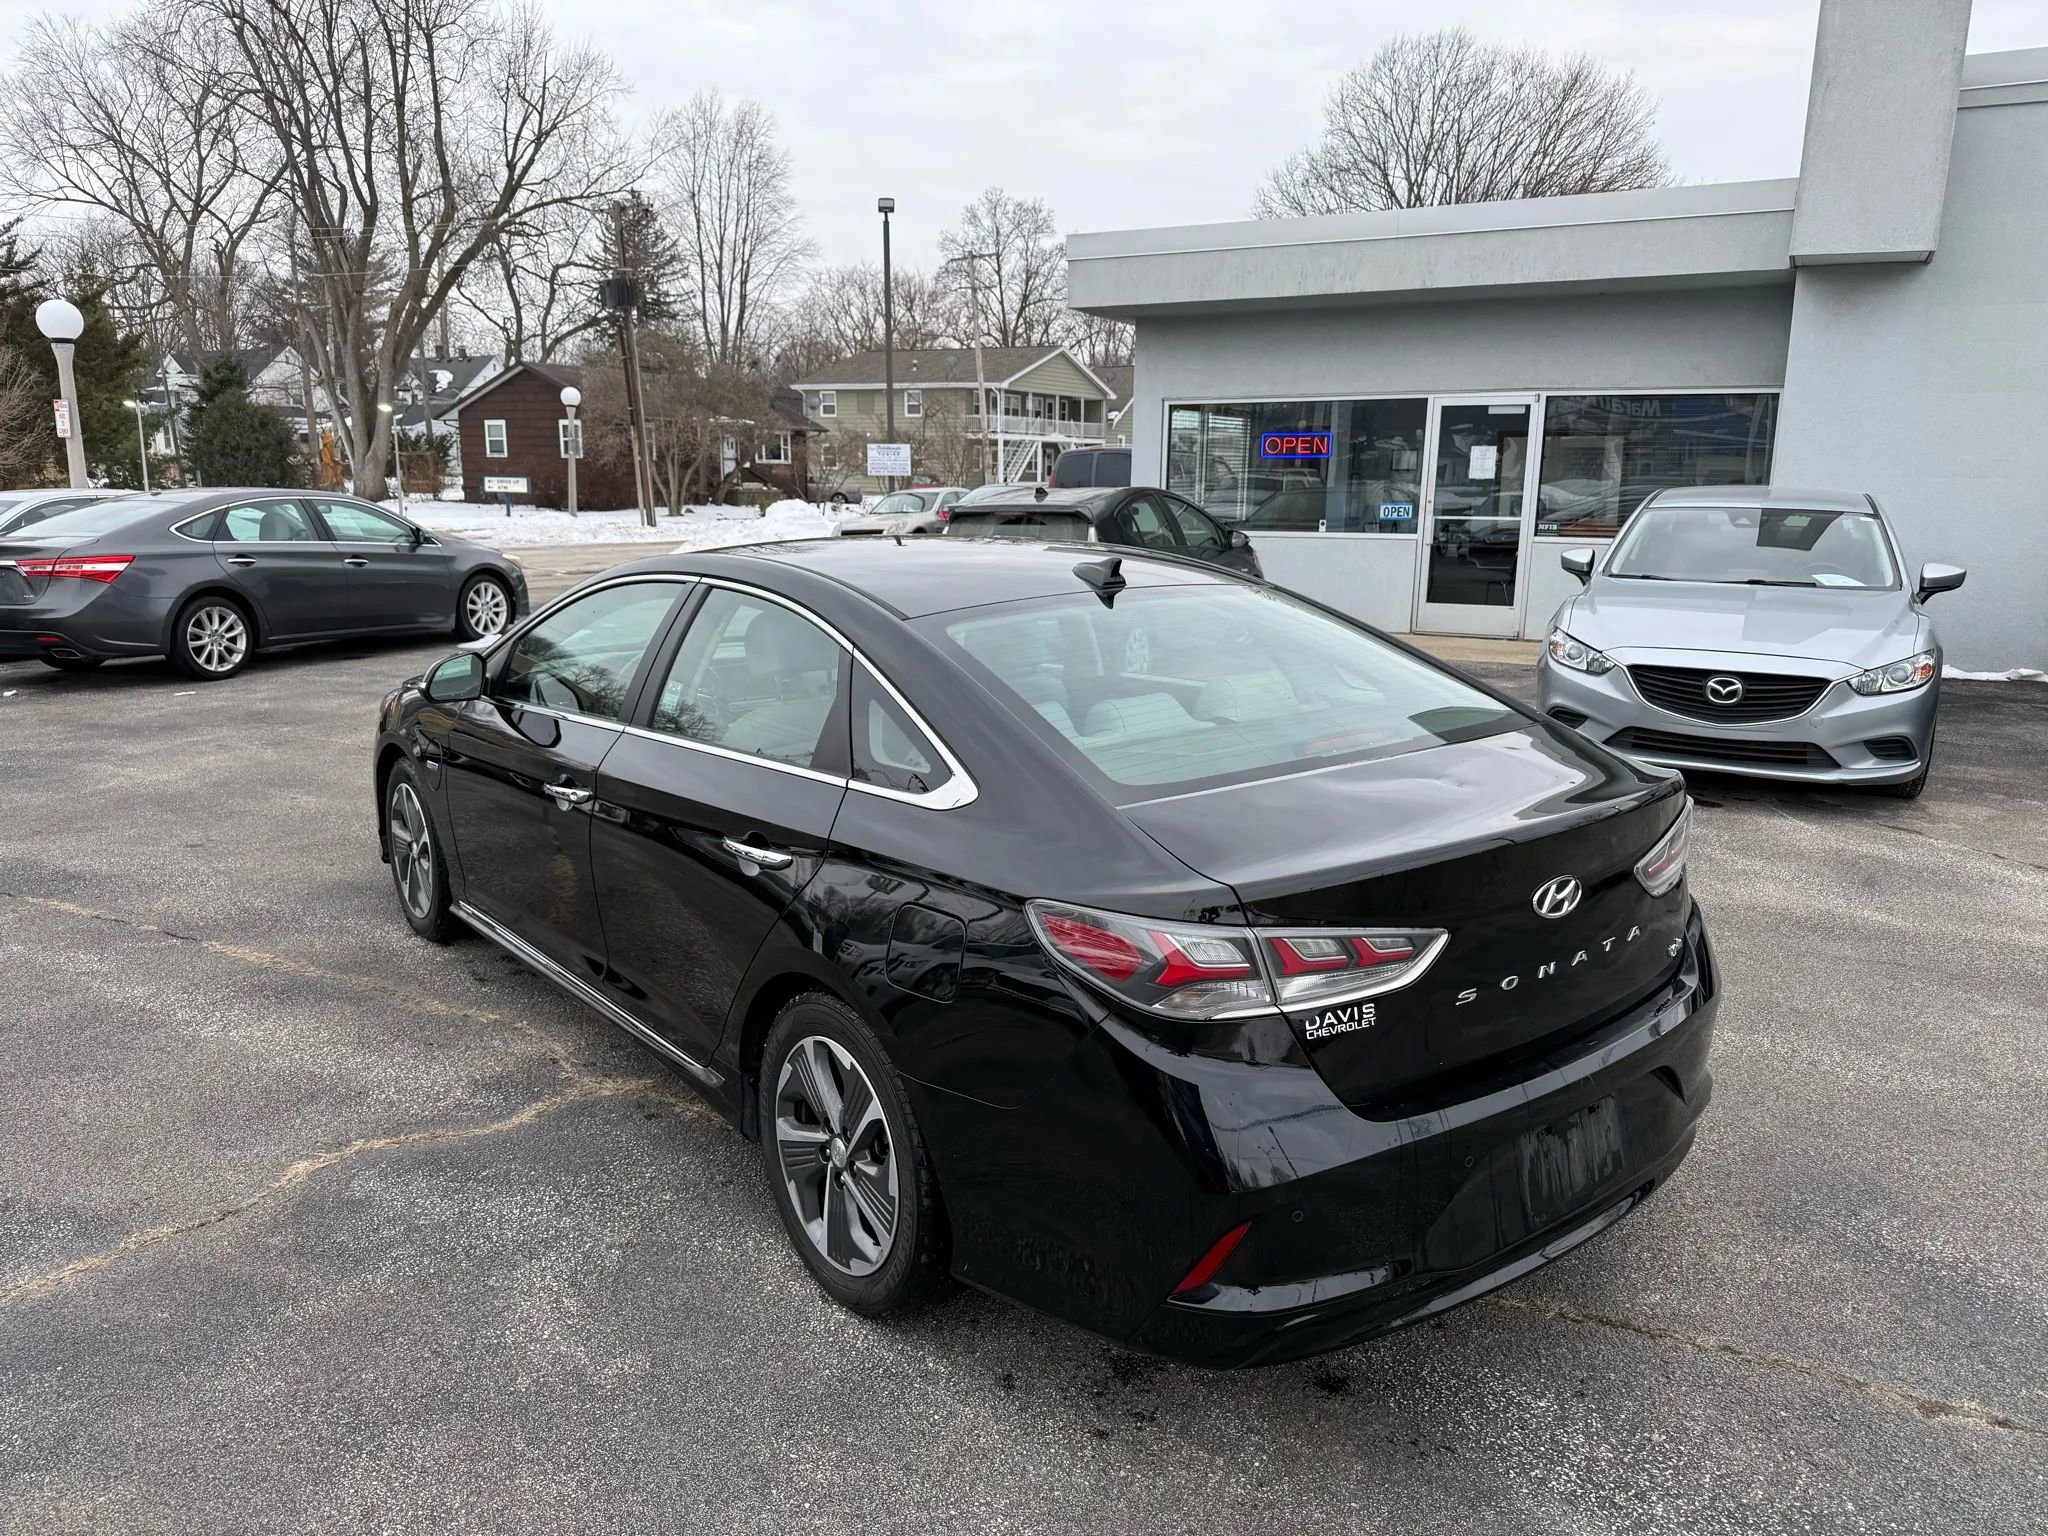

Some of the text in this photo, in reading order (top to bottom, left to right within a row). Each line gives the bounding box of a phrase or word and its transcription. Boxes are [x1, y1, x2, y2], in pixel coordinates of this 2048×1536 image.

[1265, 436, 1328, 454] OPEN
[1383, 506, 1410, 518] OPEN
[1455, 925, 1641, 1006] SONATA
[1305, 1003, 1376, 1030] DAVIS
[1306, 1017, 1376, 1040] CHEVROLET
